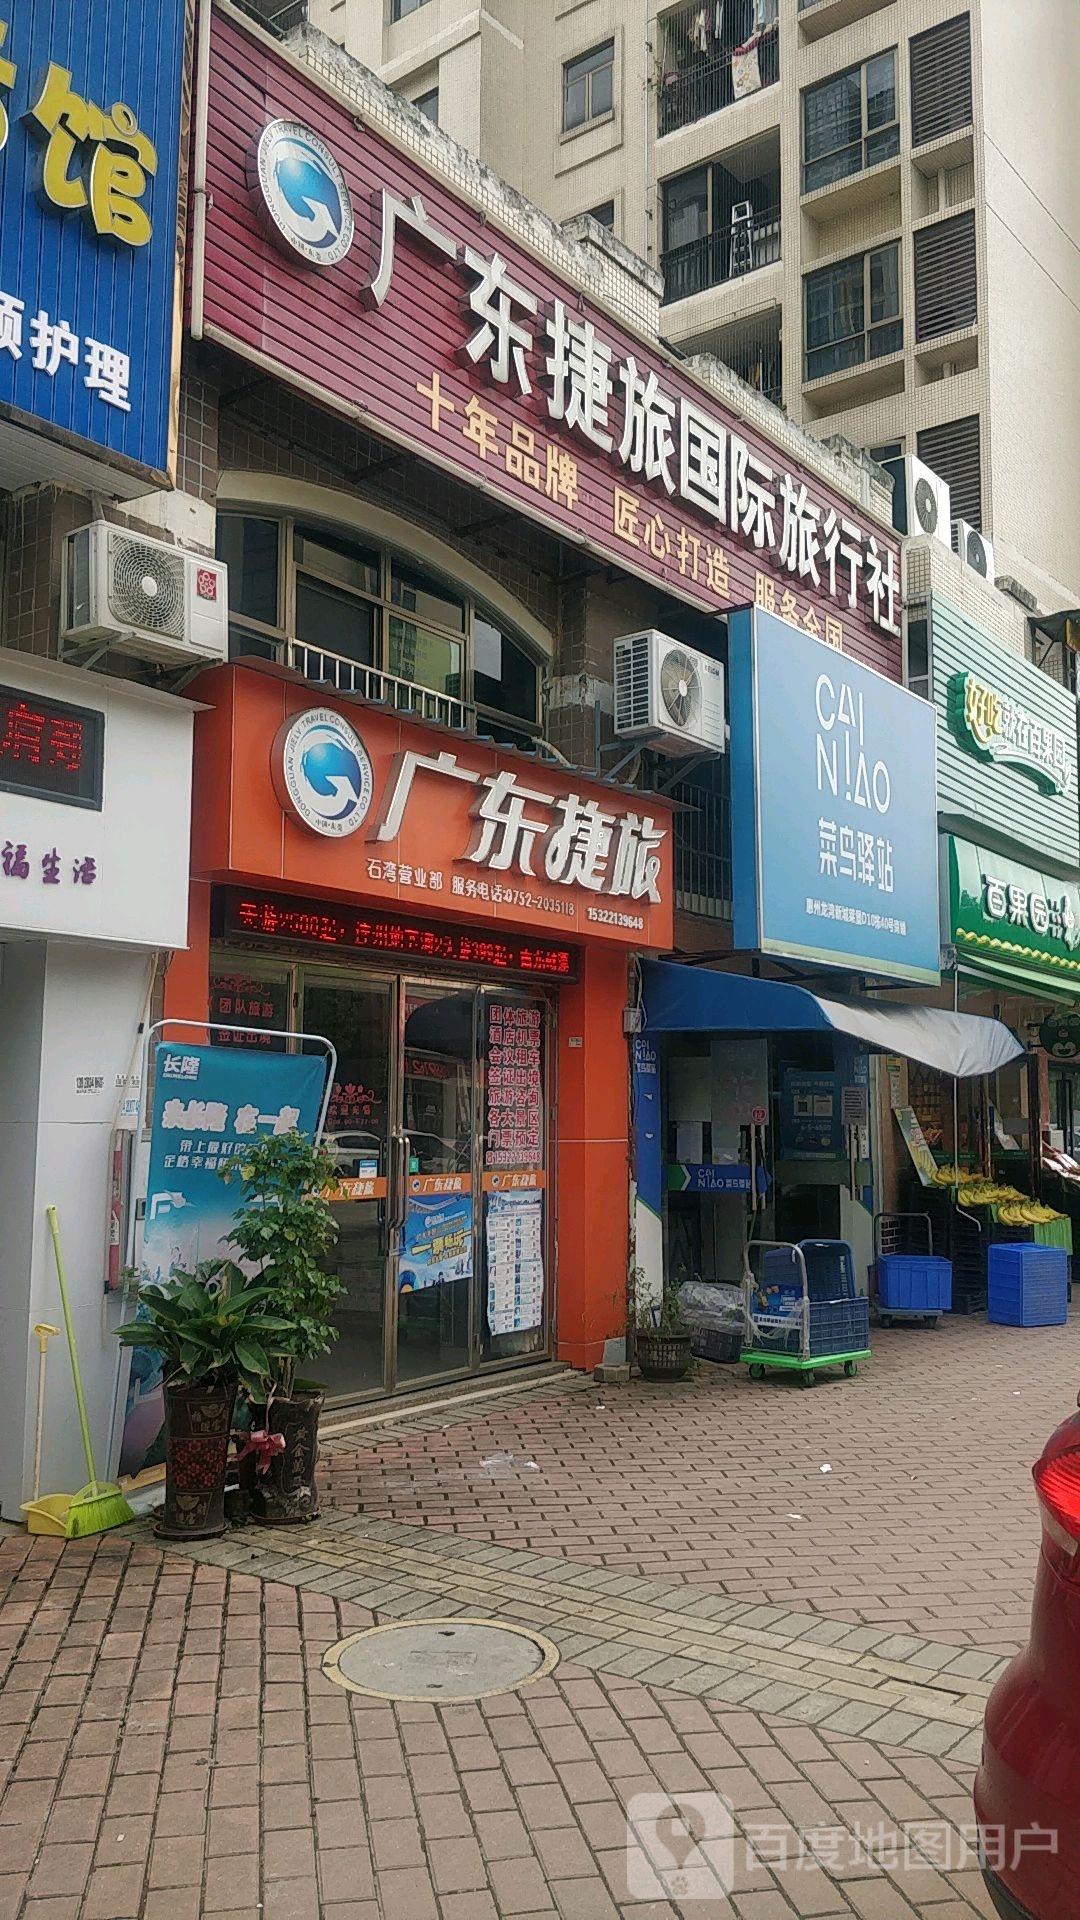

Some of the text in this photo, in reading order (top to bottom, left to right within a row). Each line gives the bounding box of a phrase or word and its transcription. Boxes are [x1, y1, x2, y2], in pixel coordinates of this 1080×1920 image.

[0, 19, 158, 247] 馆
[274, 123, 303, 138] TRAVEL
[370, 188, 900, 637] 广东捷旅国际旅行社
[416, 372, 842, 651] 十年品牌 匠心打造 服务全国
[815, 674, 864, 747] CAI
[967, 677, 1066, 774] 好吃就在百果园
[286, 757, 311, 817] DONGGUAN
[301, 713, 328, 727] TRAVEL
[330, 715, 359, 748] CONSULT
[357, 749, 370, 793] SERVICE
[377, 751, 668, 903] 广东捷旅
[1, 841, 97, 885] 福生活
[818, 817, 894, 893] 菜鸟驿站
[367, 858, 443, 891] 石湾营业部
[984, 873, 1050, 934] 百果园
[219, 997, 274, 1018] 团队旅游
[489, 1005, 541, 1027] 团体旅游
[489, 1025, 541, 1047] 酒店机票
[163, 1054, 200, 1075] 长隆
[488, 1045, 541, 1066] 会议租车
[488, 1066, 541, 1087] 签证出境
[488, 1087, 540, 1108] 旅游咨询
[488, 1108, 540, 1128] 各大景区
[488, 1129, 540, 1149] 门票预定
[423, 1177, 462, 1192] 广东捷旅
[502, 1174, 537, 1188] 广东捷旅
